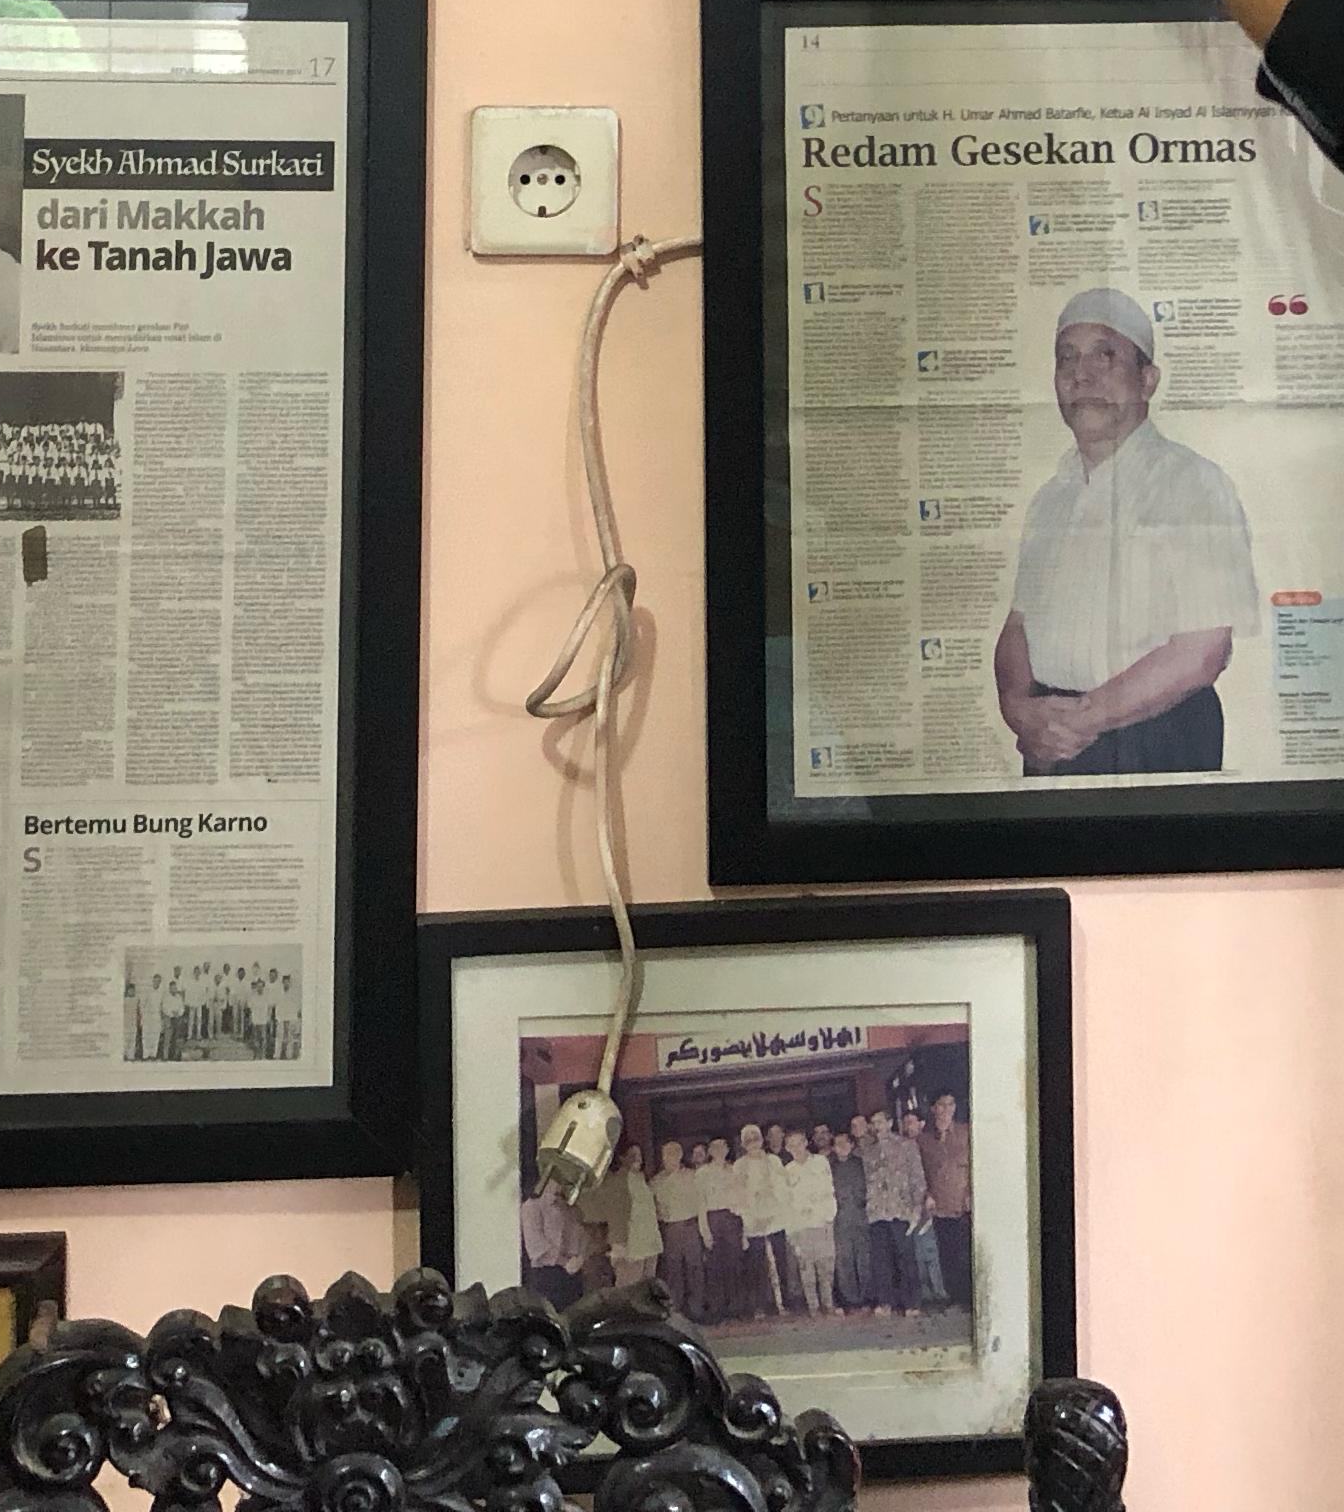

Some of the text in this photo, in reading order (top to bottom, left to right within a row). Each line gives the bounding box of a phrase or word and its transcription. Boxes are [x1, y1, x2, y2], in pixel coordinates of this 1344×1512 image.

[802, 34, 820, 49] 14
[310, 57, 337, 78] 17
[831, 109, 899, 124] Pertanyaan
[903, 109, 938, 122] untuk
[1100, 105, 1134, 119] Ketua
[802, 131, 1257, 168] Redam Gesekan Ormas
[32, 147, 325, 184] Syekh Ahmad Surkati
[36, 198, 265, 231] dari Makkah
[35, 238, 292, 281] ke Tanah Jawa
[24, 813, 268, 839] Bertemu Bung Karno
